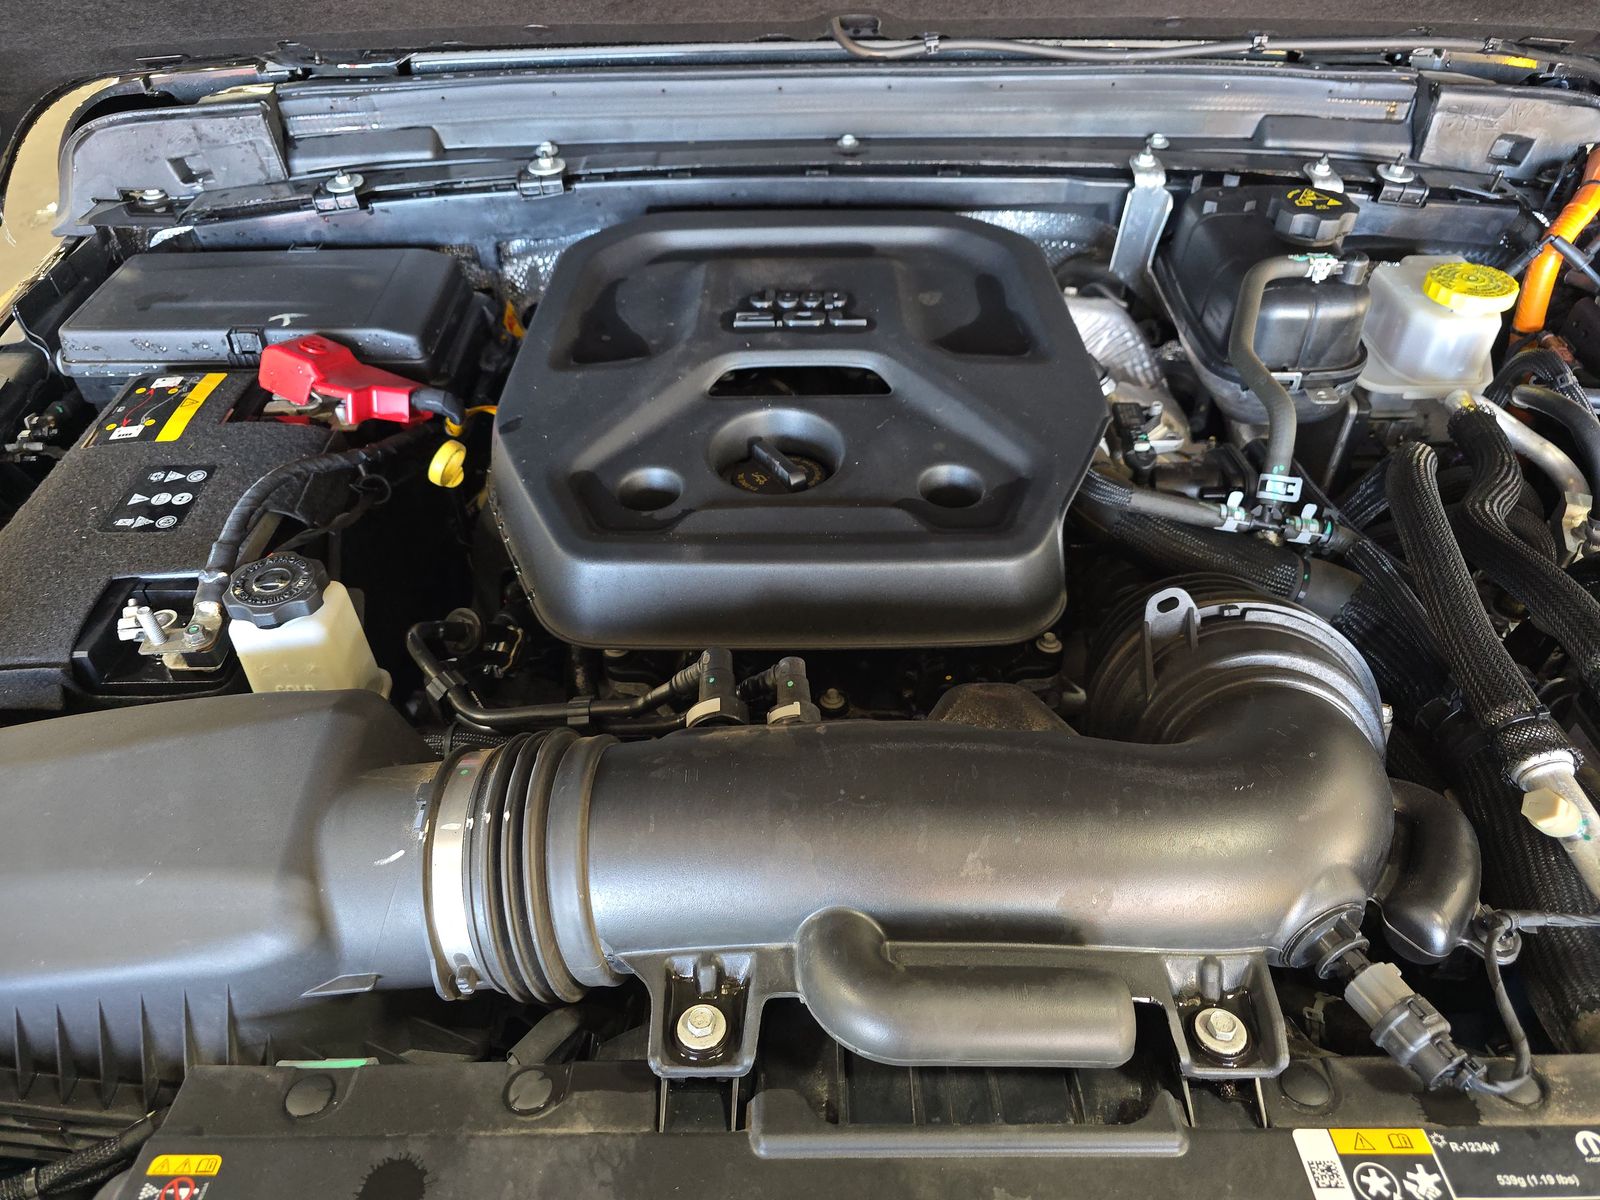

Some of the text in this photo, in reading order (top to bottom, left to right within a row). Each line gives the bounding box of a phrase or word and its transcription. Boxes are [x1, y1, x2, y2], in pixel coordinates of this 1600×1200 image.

[750, 289, 848, 308] Jeep
[733, 311, 867, 328] 2.0L
[1449, 1141, 1500, 1155] R-1234yf
[1496, 1173, 1580, 1188] 539g (1.19 lbs)
